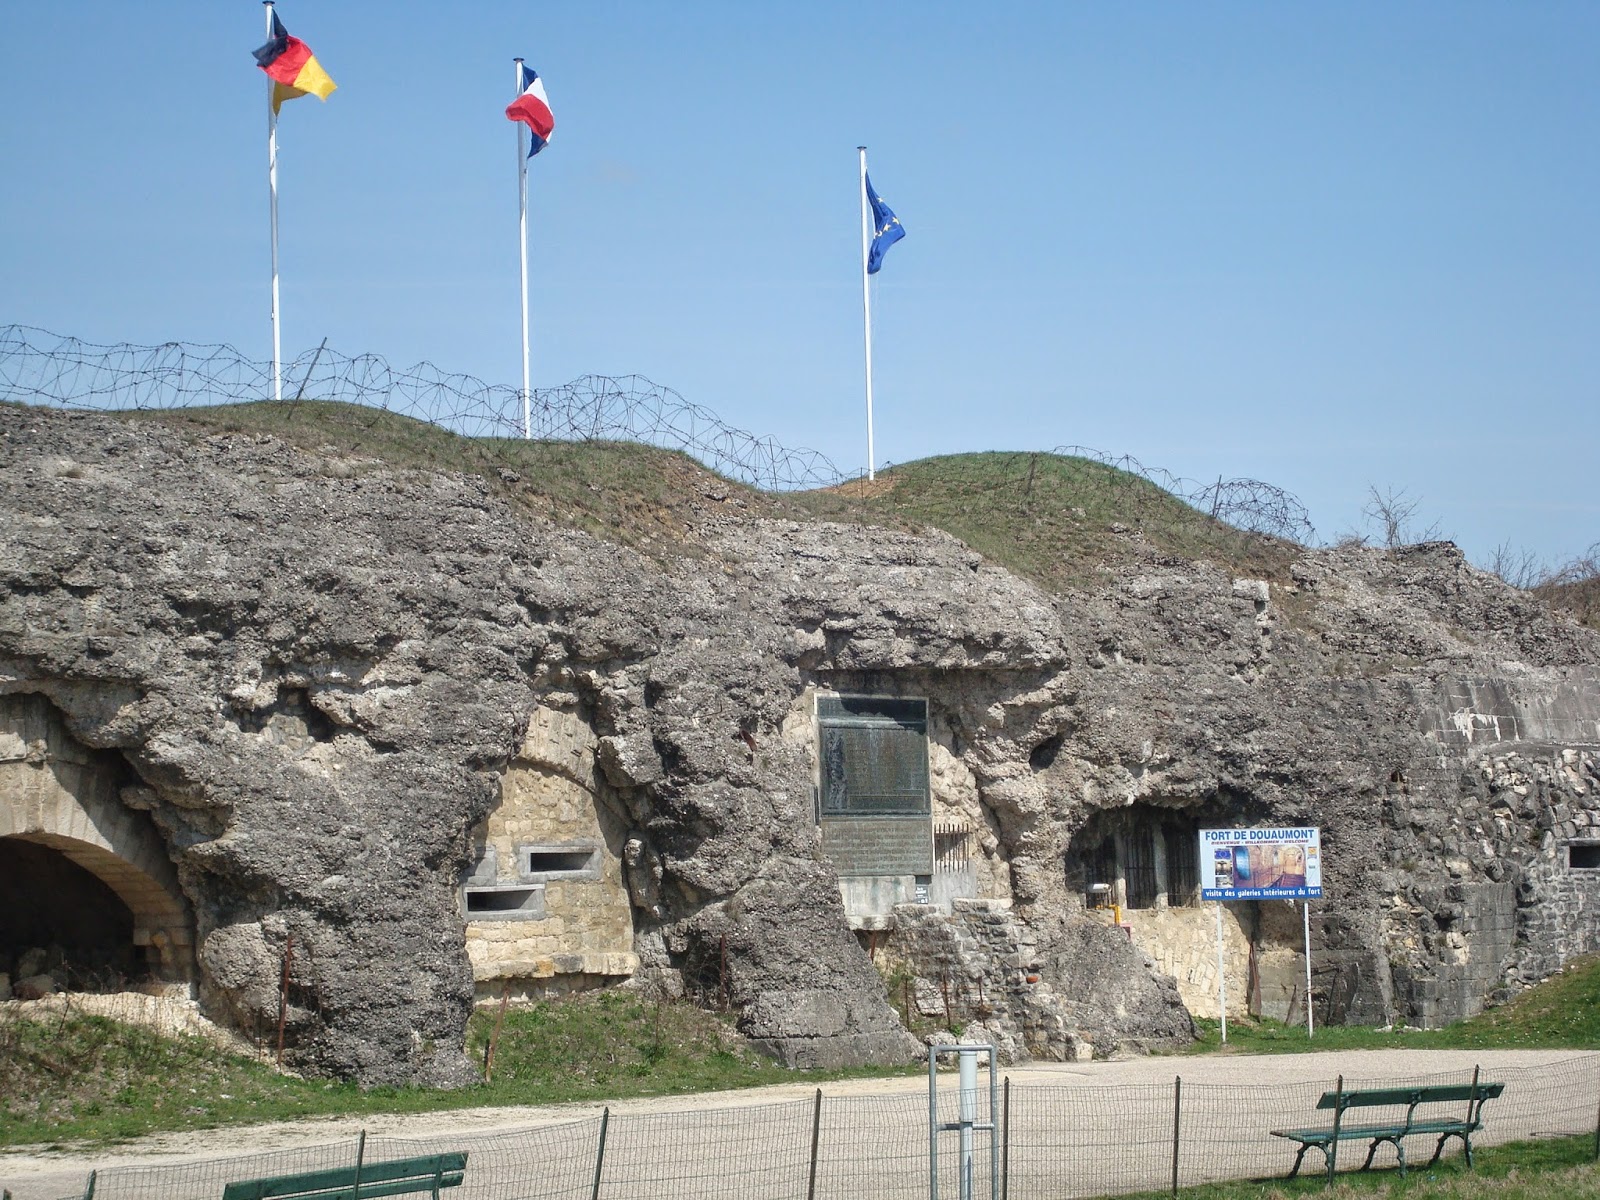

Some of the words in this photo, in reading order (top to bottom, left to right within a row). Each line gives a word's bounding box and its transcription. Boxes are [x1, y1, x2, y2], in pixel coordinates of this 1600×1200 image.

[1205, 831, 1231, 841] FORT
[1234, 831, 1247, 840] DE
[1250, 829, 1314, 840] DOUAUMONT
[1238, 889, 1261, 898] galeries
